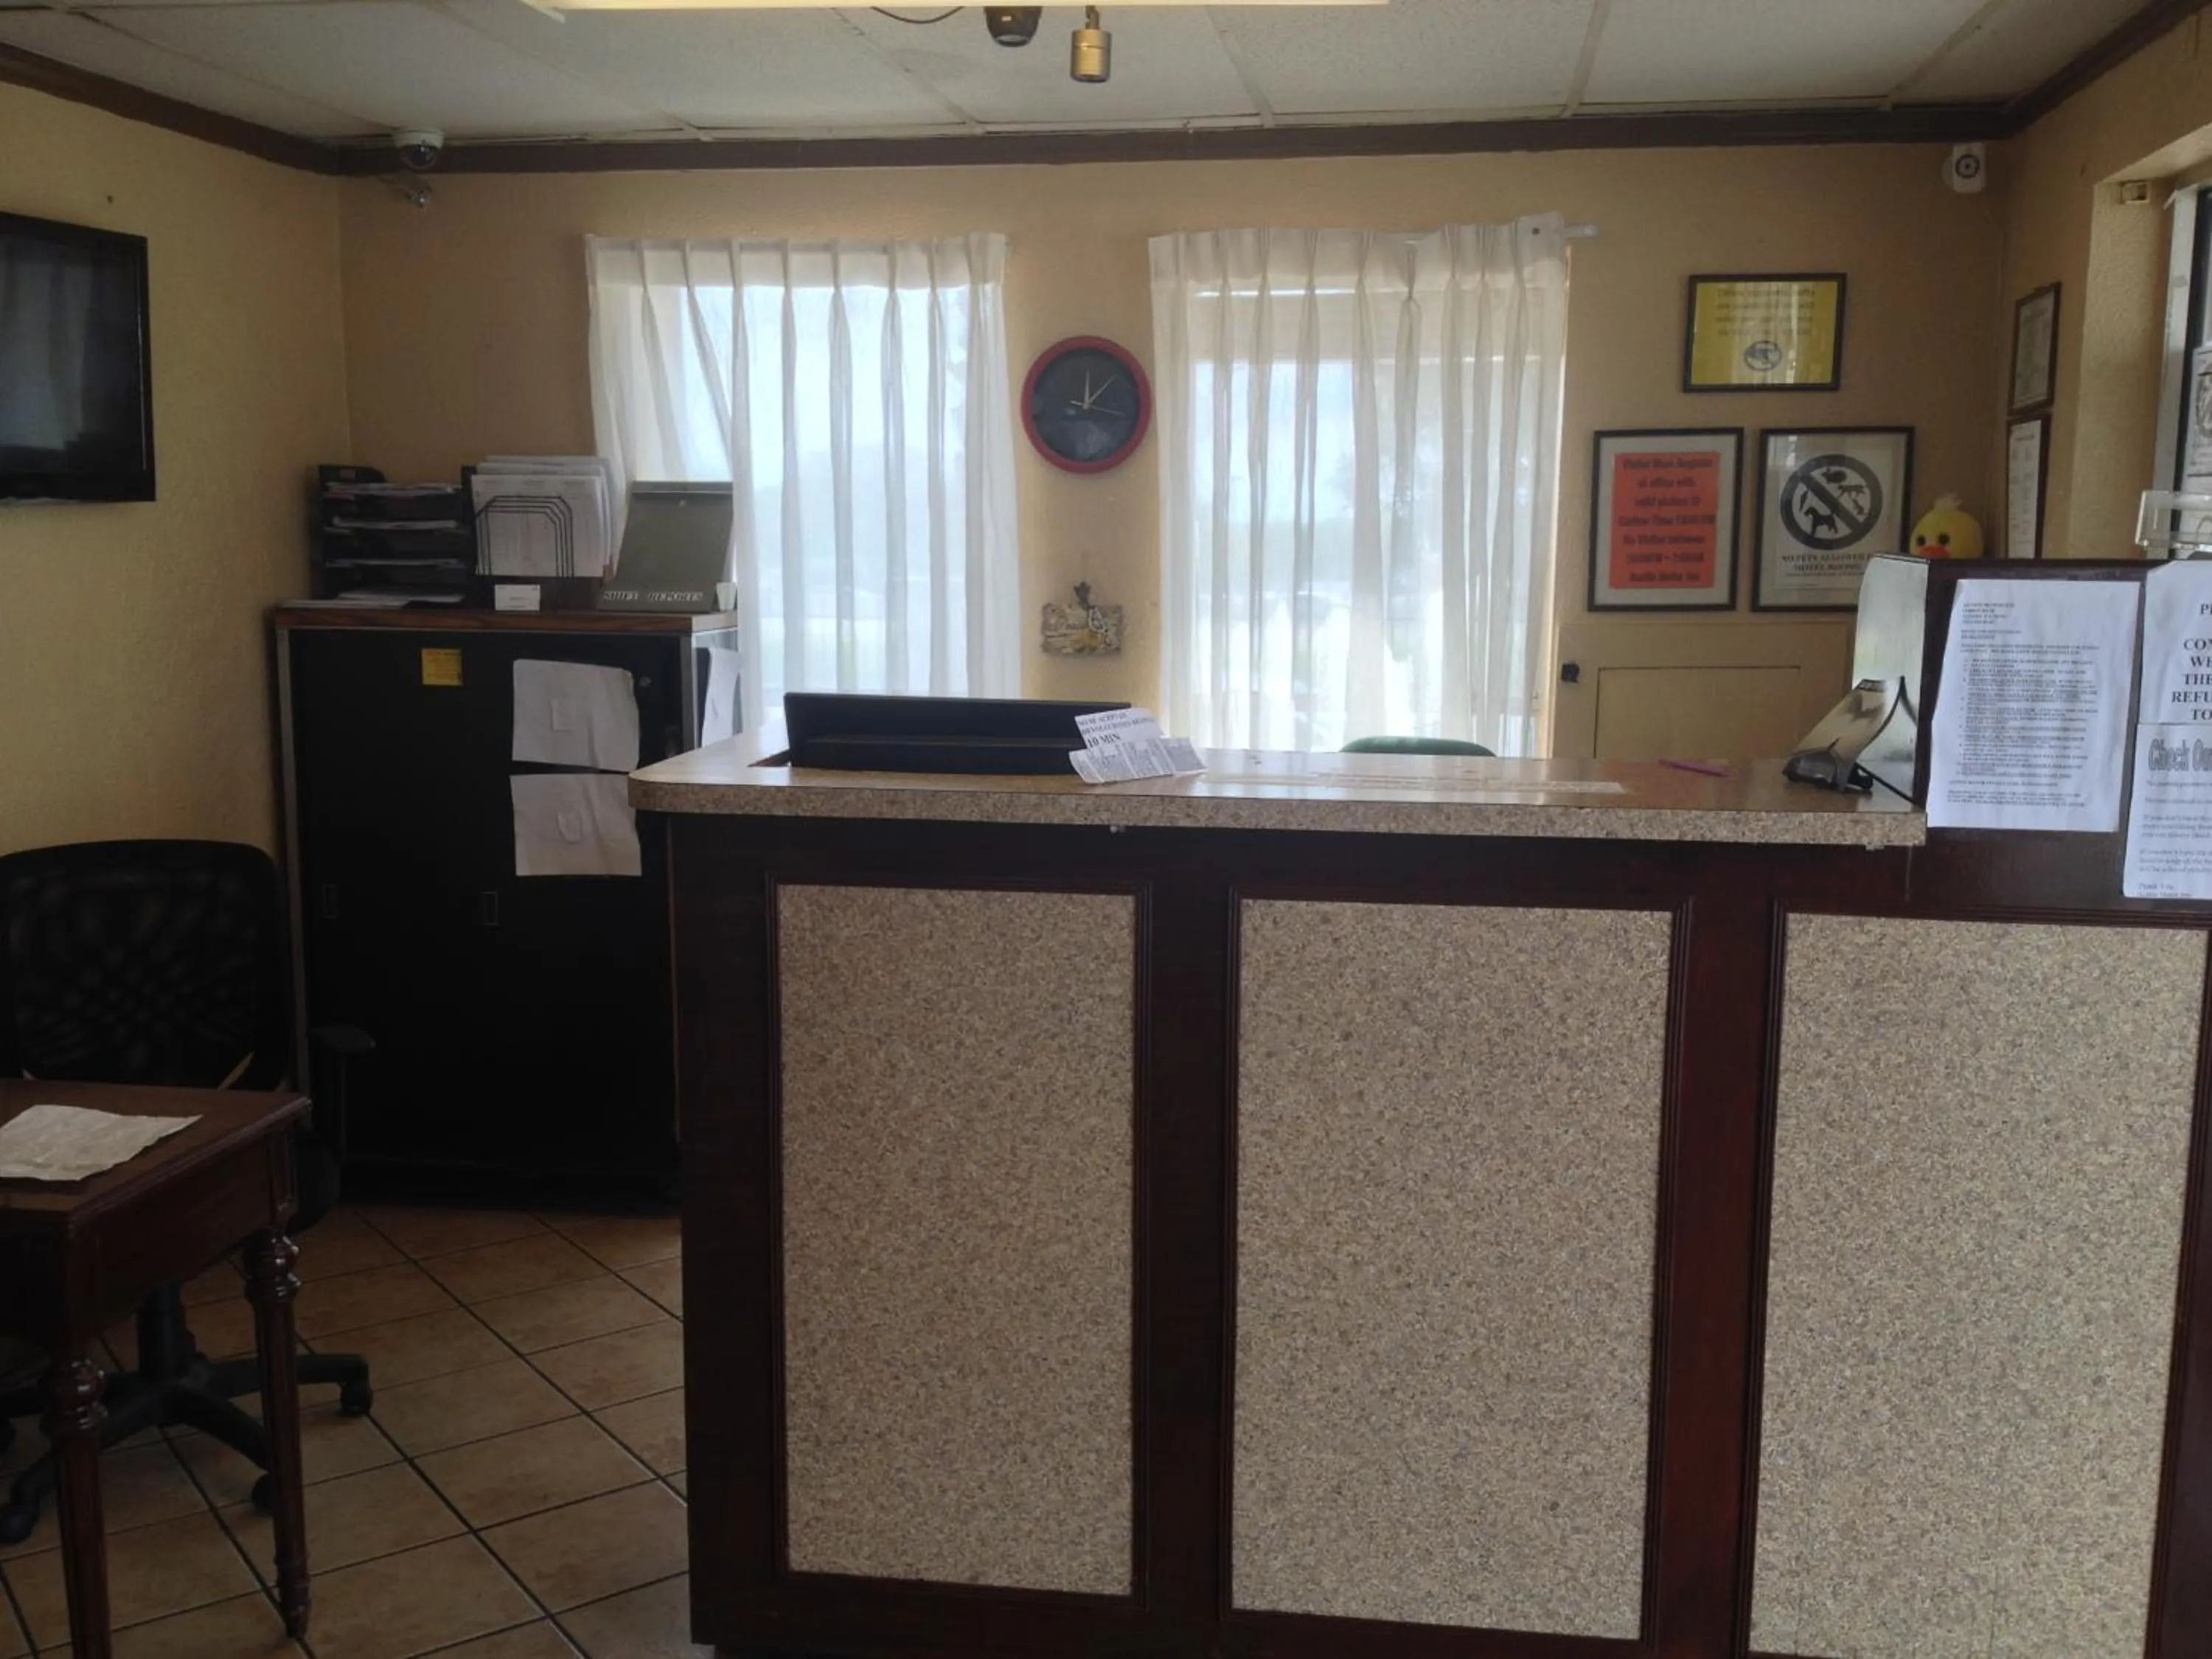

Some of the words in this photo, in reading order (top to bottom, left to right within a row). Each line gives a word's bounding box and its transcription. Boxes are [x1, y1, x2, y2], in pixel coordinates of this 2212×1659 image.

[1820, 553, 1865, 562] ALLOWED
[1087, 736, 1099, 748] 10
[1099, 732, 1121, 744] MIN
[2148, 738, 2189, 772] Check
